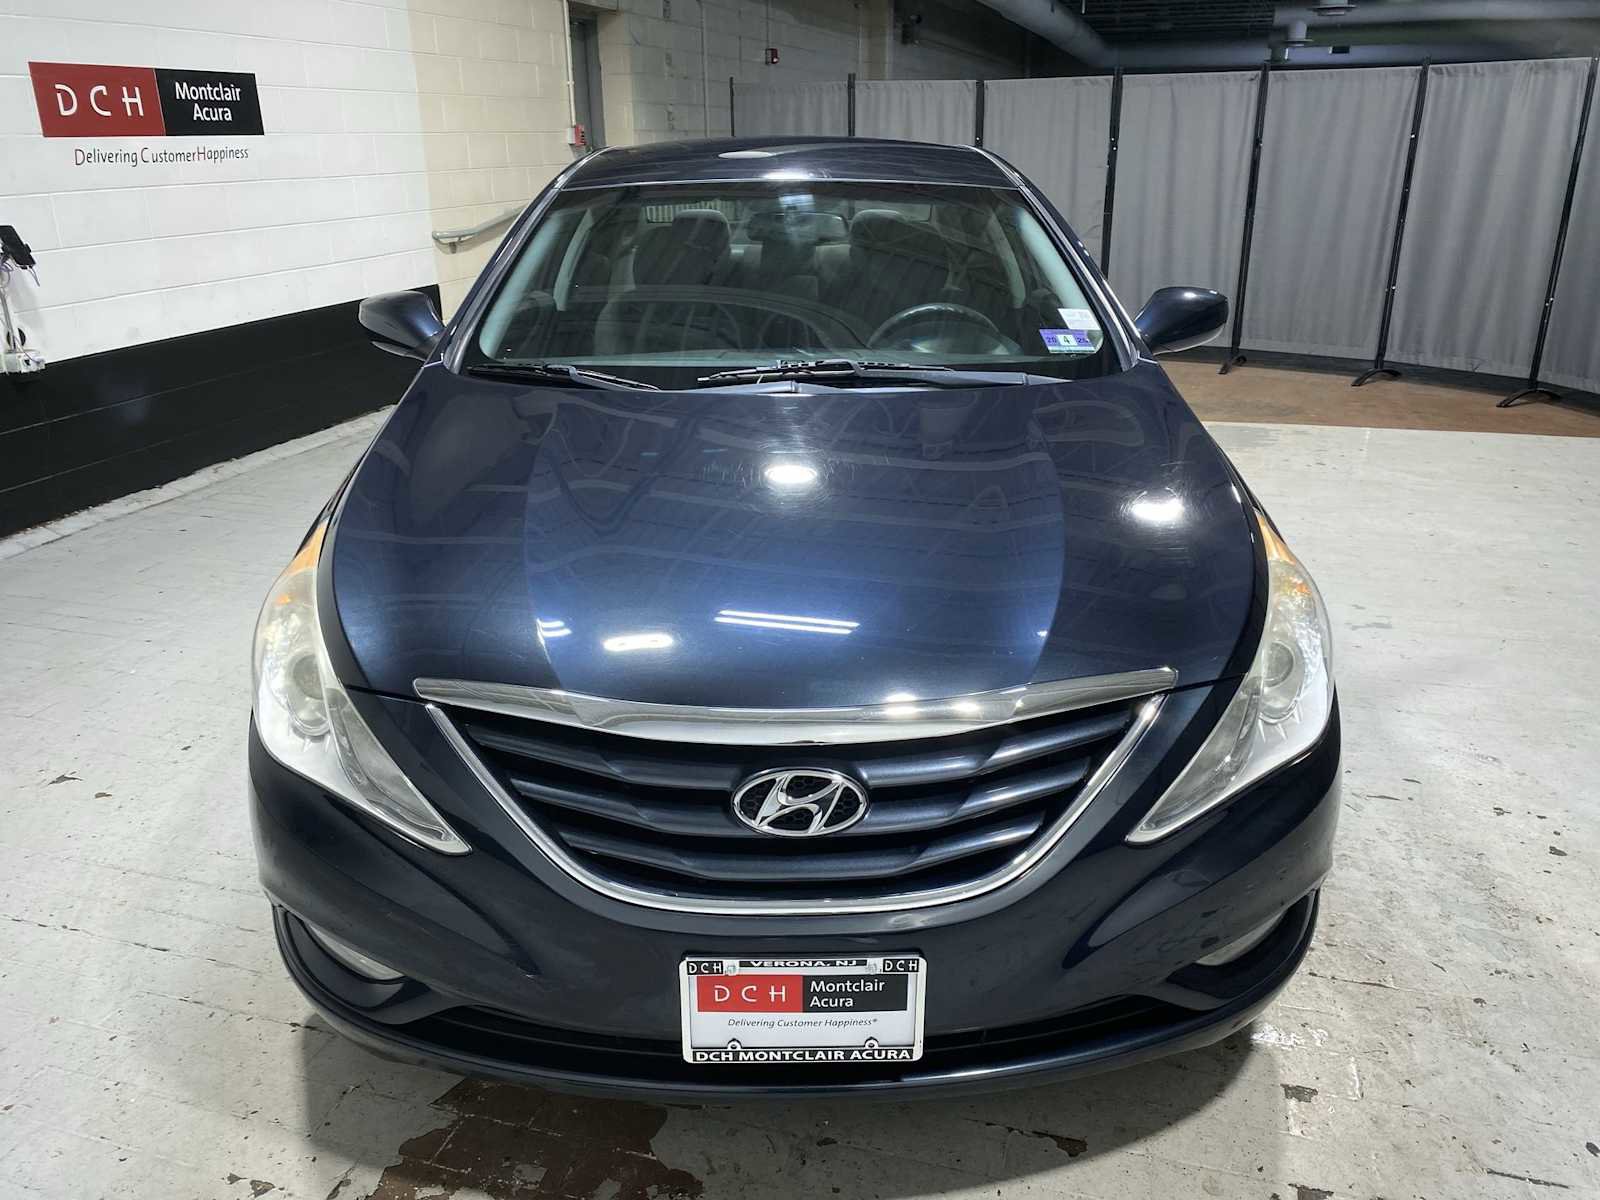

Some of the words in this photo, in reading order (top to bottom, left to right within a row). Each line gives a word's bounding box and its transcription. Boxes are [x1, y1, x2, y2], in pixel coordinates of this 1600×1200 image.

[175, 81, 242, 102] Montclair
[55, 83, 144, 117] DCH
[193, 103, 233, 122] Acura
[74, 148, 138, 168] Delivering
[688, 962, 722, 974] DCH
[884, 960, 918, 972] DCH
[810, 979, 885, 993] Montclair
[713, 984, 786, 1003] DCH
[810, 996, 854, 1008] Acura
[728, 1018, 775, 1029] Delivering
[777, 1018, 823, 1028] Customer
[695, 1051, 734, 1061] DCH
[738, 1050, 845, 1061] MONTCLAIR
[849, 1049, 911, 1060] ACURA
